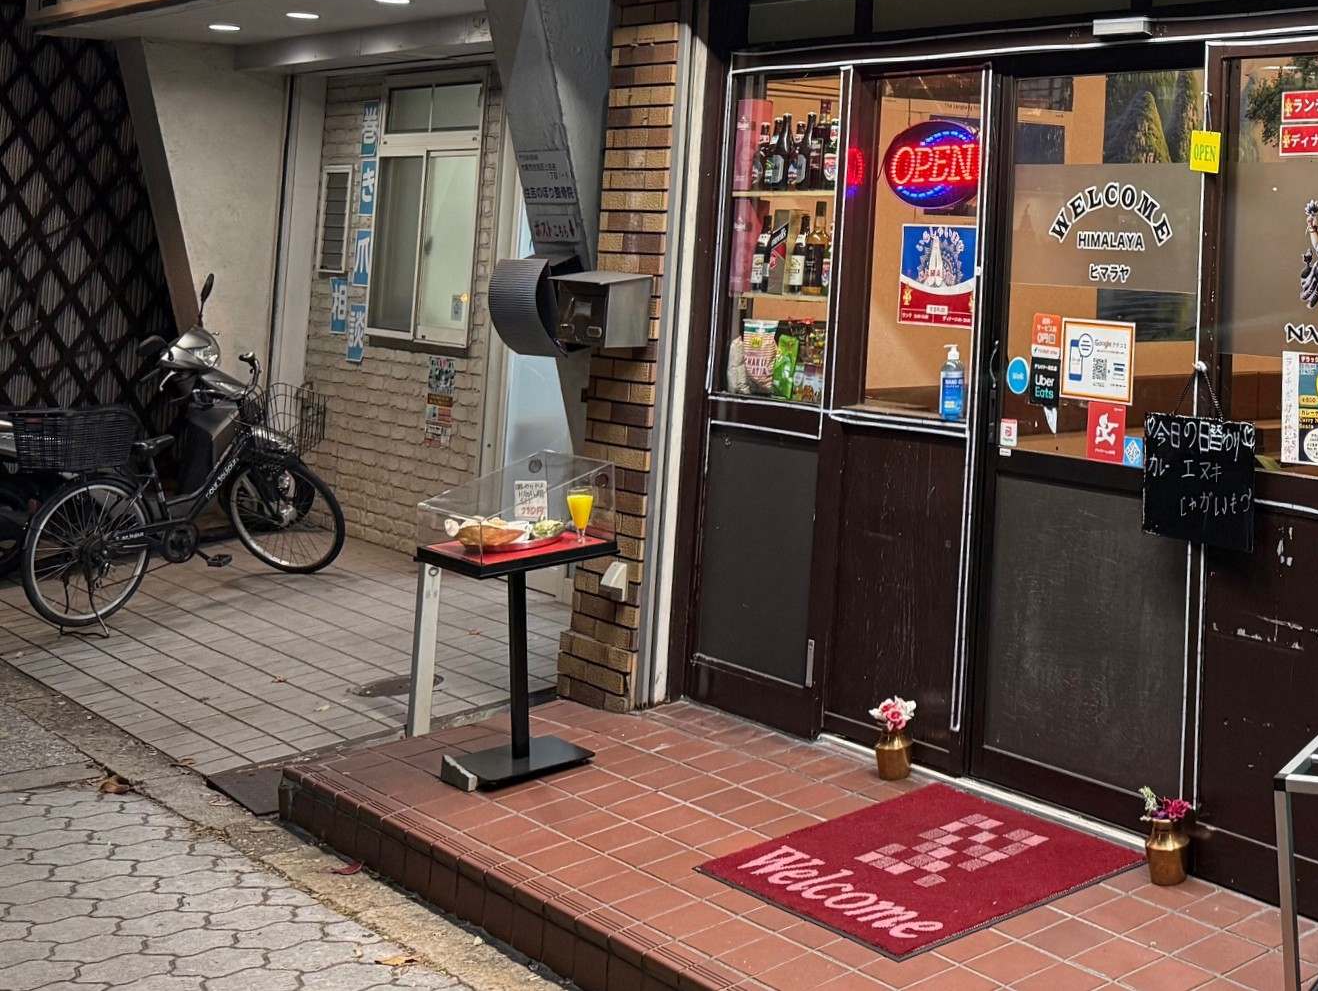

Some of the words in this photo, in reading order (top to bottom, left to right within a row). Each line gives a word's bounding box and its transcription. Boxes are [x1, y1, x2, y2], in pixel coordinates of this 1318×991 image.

[1194, 145, 1216, 162] OPEN
[891, 144, 974, 186] OPEN
[1049, 182, 1173, 247] WELCOME
[1077, 231, 1145, 251] HIMALAYA
[1089, 264, 1130, 283] ヒマラヤ
[1095, 339, 1111, 348] Google
[1035, 375, 1054, 387] Uber
[1035, 388, 1054, 398] Eats
[737, 845, 945, 940] Welcome
